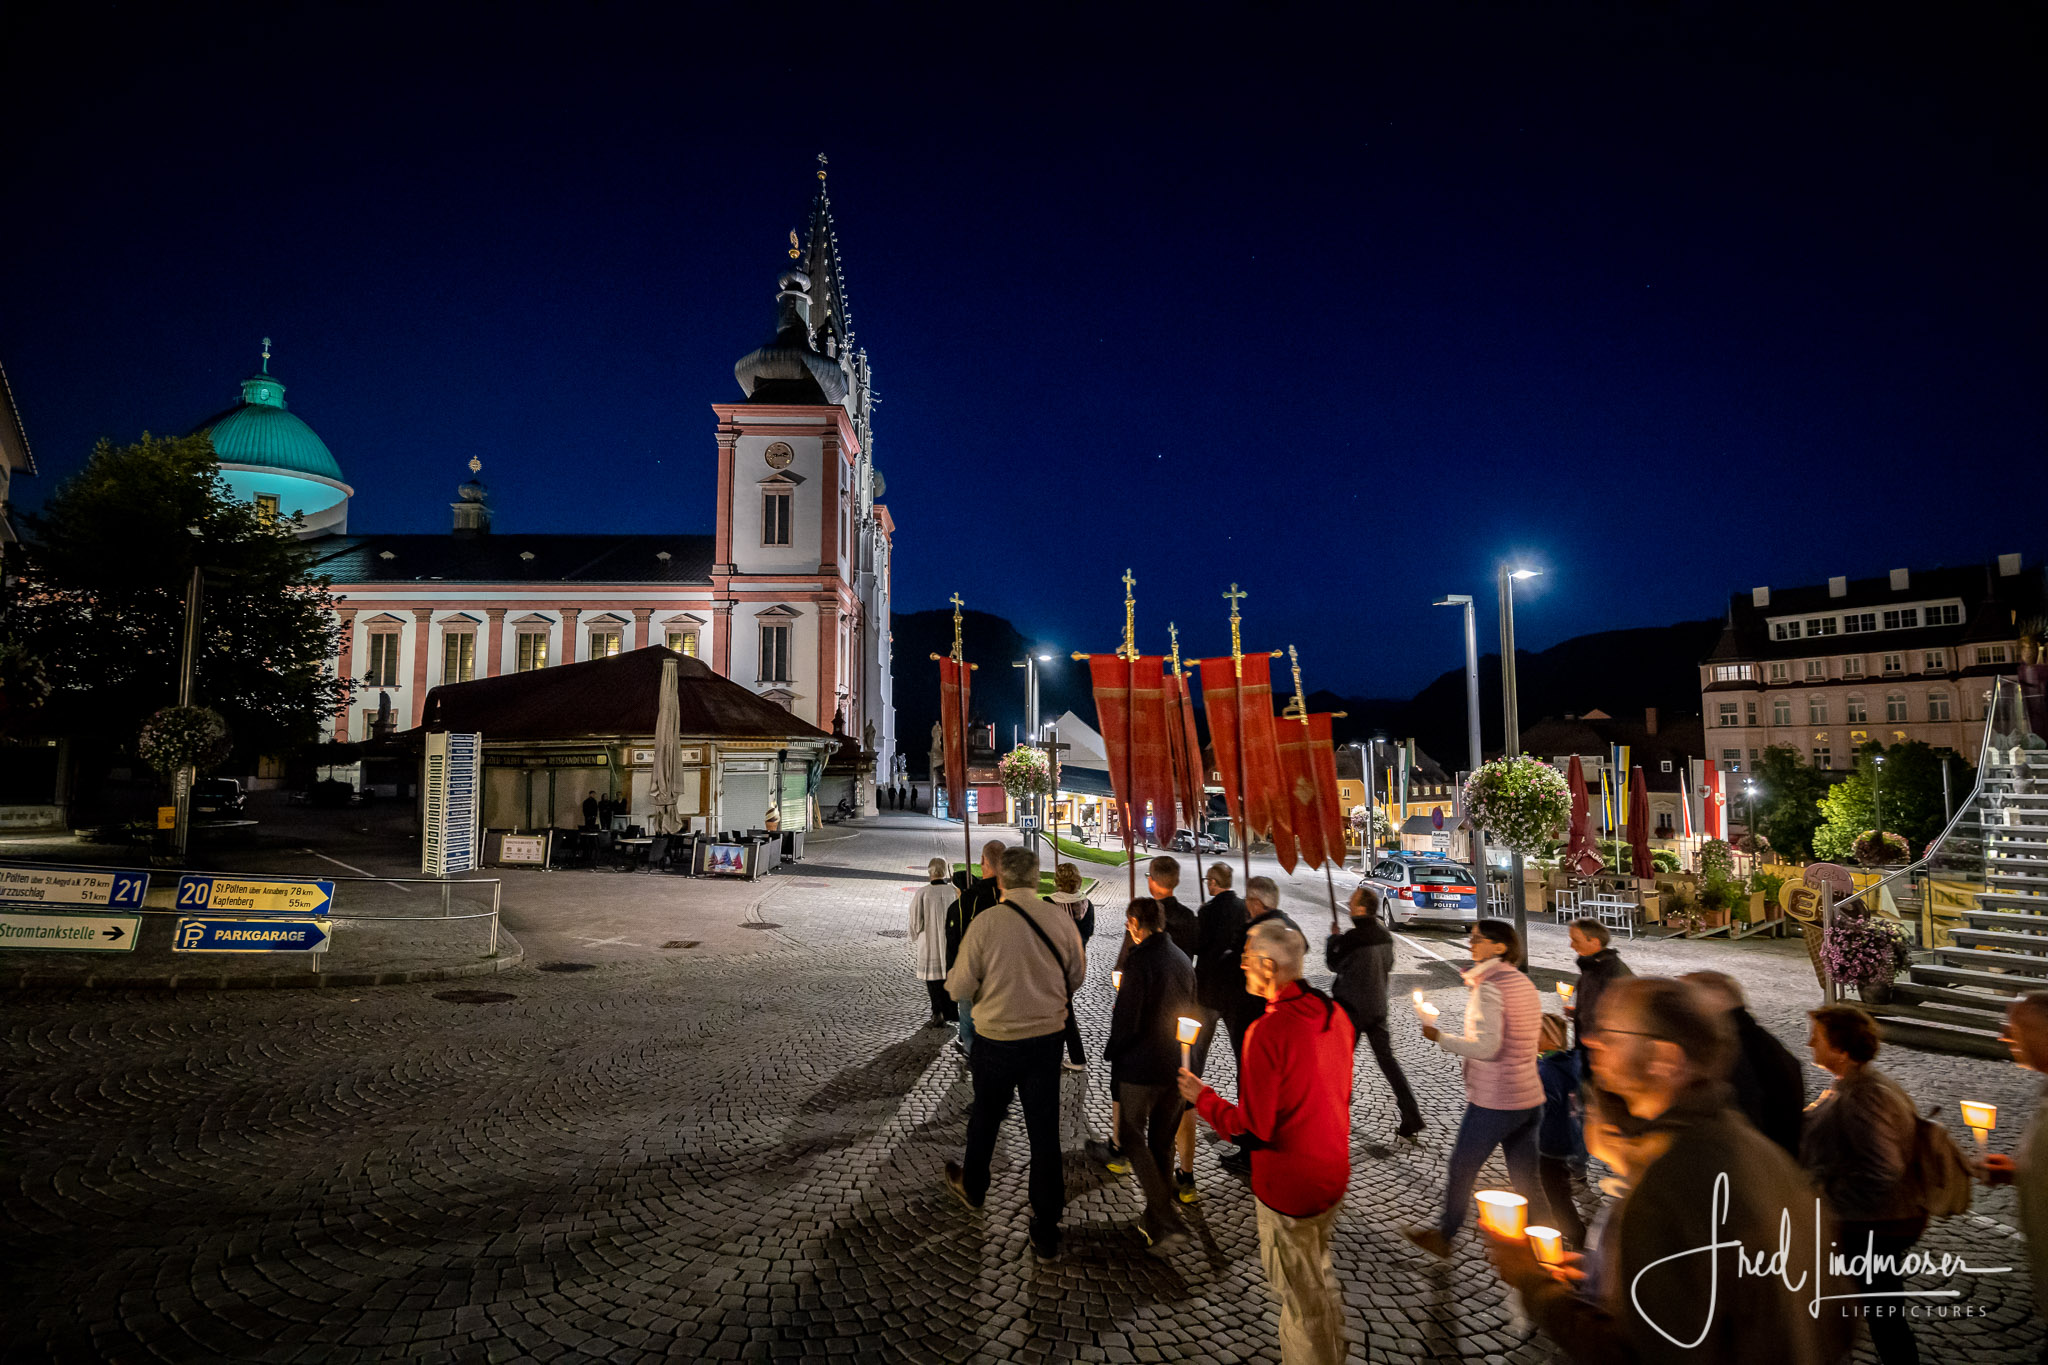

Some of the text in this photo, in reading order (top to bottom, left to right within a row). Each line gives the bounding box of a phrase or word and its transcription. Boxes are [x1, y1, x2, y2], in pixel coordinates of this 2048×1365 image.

[82, 877, 96, 887] 78
[97, 879, 110, 888] km
[81, 890, 94, 900] 51
[94, 892, 107, 901] km
[114, 879, 142, 902] 21
[180, 882, 209, 905] 20
[249, 886, 262, 894] über
[262, 887, 288, 897] Annaberg
[290, 886, 302, 896] 78
[302, 888, 314, 896] km
[213, 896, 311, 908] Kapfenberg 55 km
[0, 922, 95, 940] Stromtankstelle
[214, 929, 306, 941] PARKGARAGE
